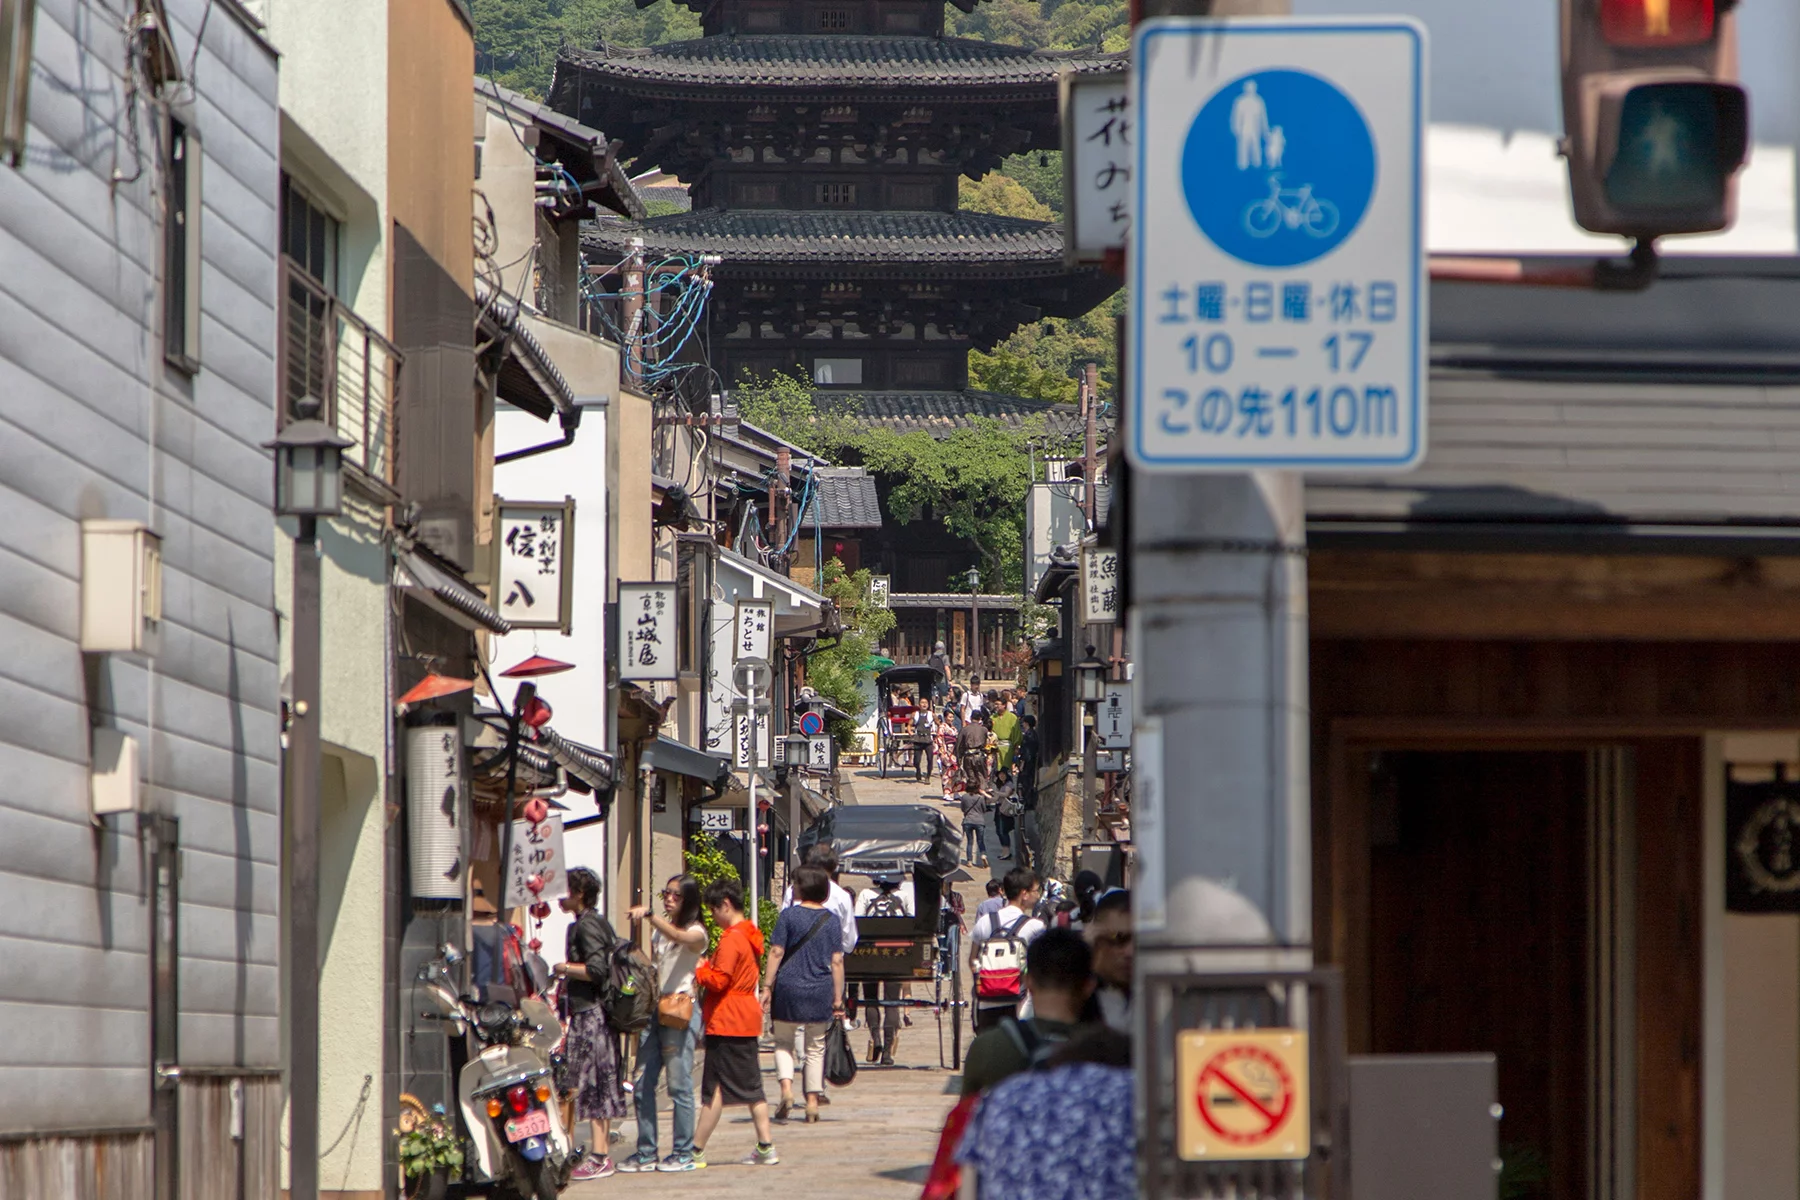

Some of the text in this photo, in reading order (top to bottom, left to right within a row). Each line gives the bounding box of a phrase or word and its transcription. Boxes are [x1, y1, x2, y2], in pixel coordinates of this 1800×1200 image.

[1158, 282, 1397, 323] 土曜・日曜・休日
[1158, 386, 1398, 437] この先110m
